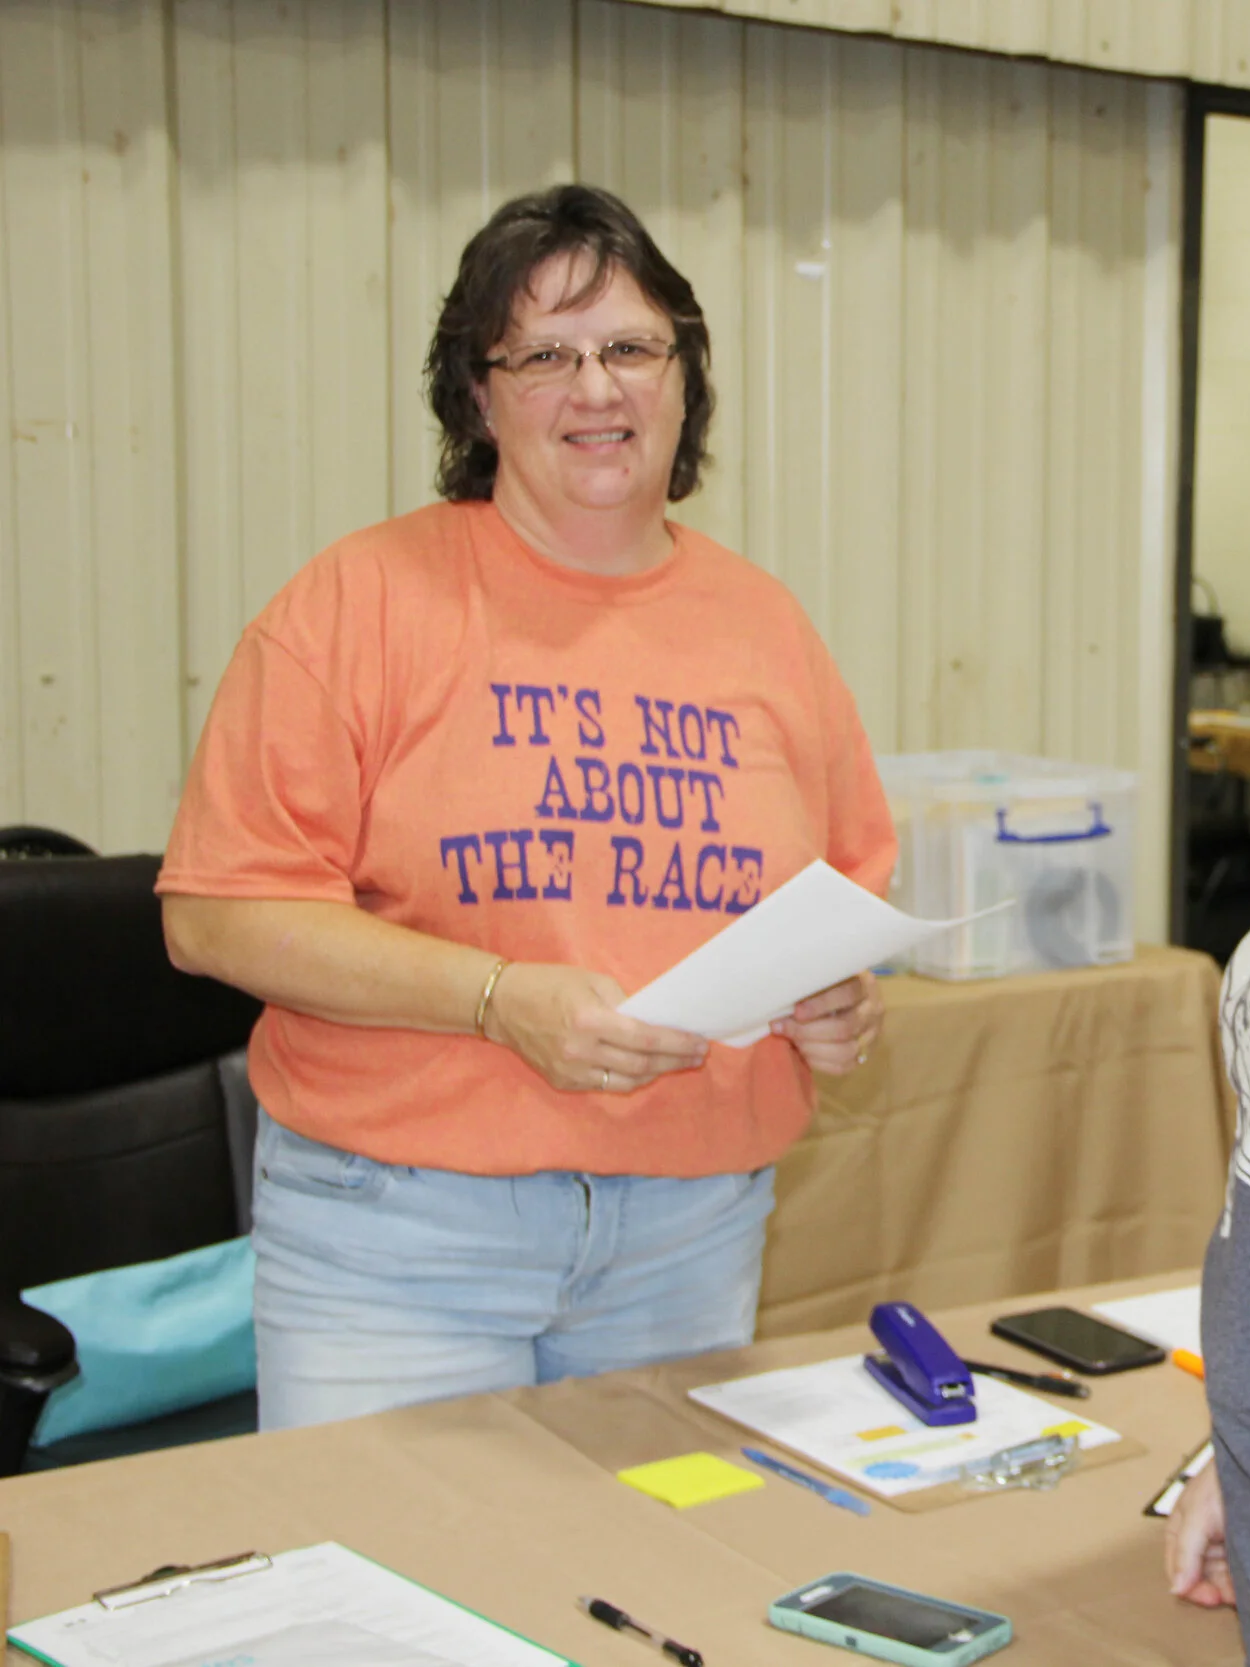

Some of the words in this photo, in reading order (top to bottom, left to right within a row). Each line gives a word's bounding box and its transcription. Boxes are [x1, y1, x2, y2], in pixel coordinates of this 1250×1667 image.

[490, 683, 605, 748] IT'S
[634, 694, 740, 769] NOT
[535, 755, 724, 832] ABOUT
[440, 829, 574, 905] THE
[607, 835, 763, 915] RACE
